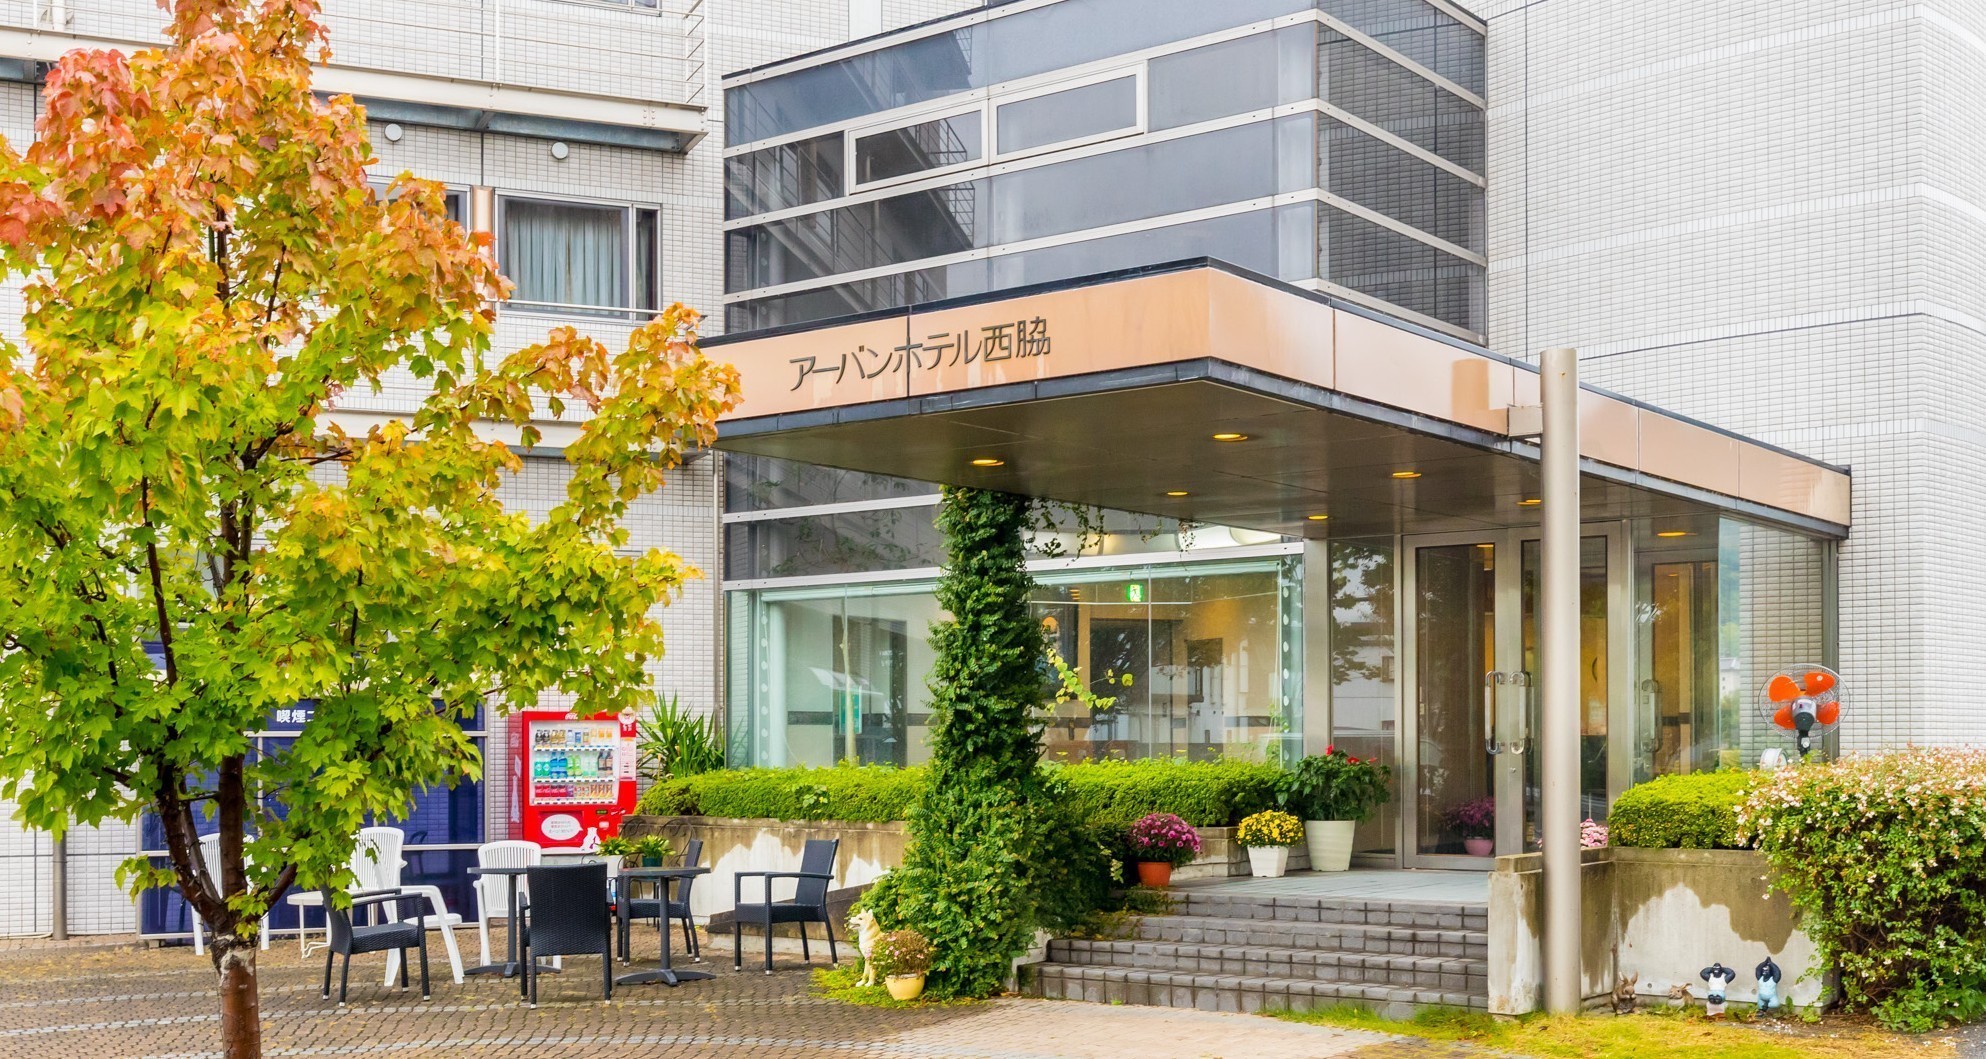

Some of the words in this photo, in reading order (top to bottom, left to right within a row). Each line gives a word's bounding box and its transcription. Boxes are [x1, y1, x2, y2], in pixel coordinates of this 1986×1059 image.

[789, 316, 1051, 392] アーバンホテル西脇
